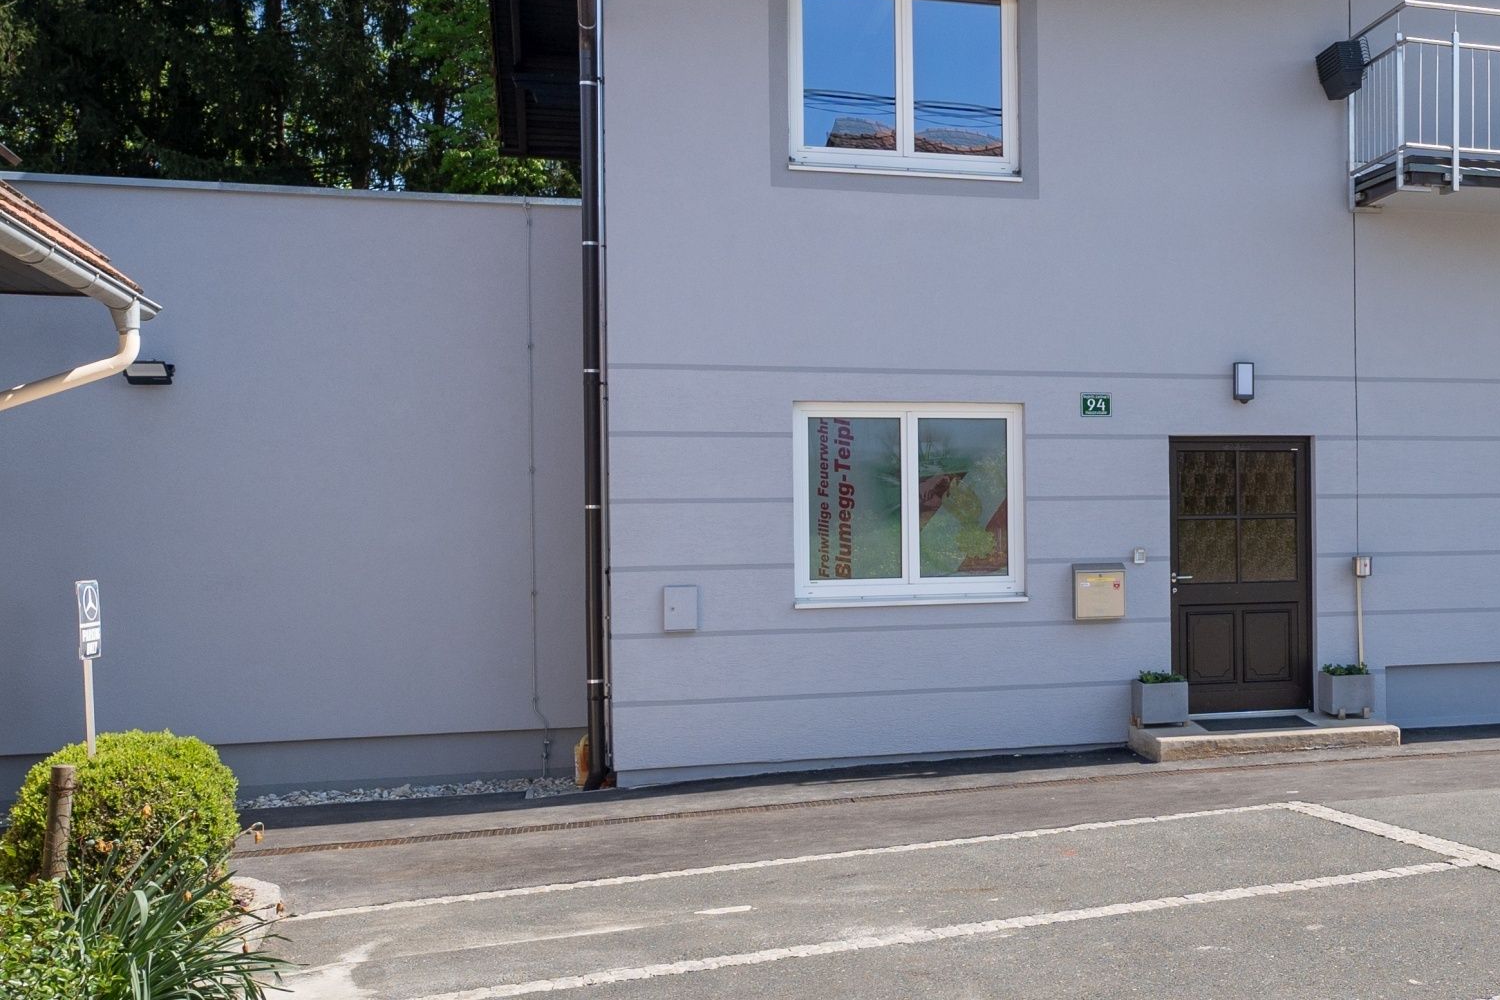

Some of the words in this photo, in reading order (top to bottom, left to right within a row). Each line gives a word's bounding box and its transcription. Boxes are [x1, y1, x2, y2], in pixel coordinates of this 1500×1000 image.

[1087, 398, 1106, 411] 94
[816, 417, 829, 497] Feuerwehr
[833, 417, 855, 579] Blumegg-Teipl
[817, 501, 832, 578] Freiwillige
